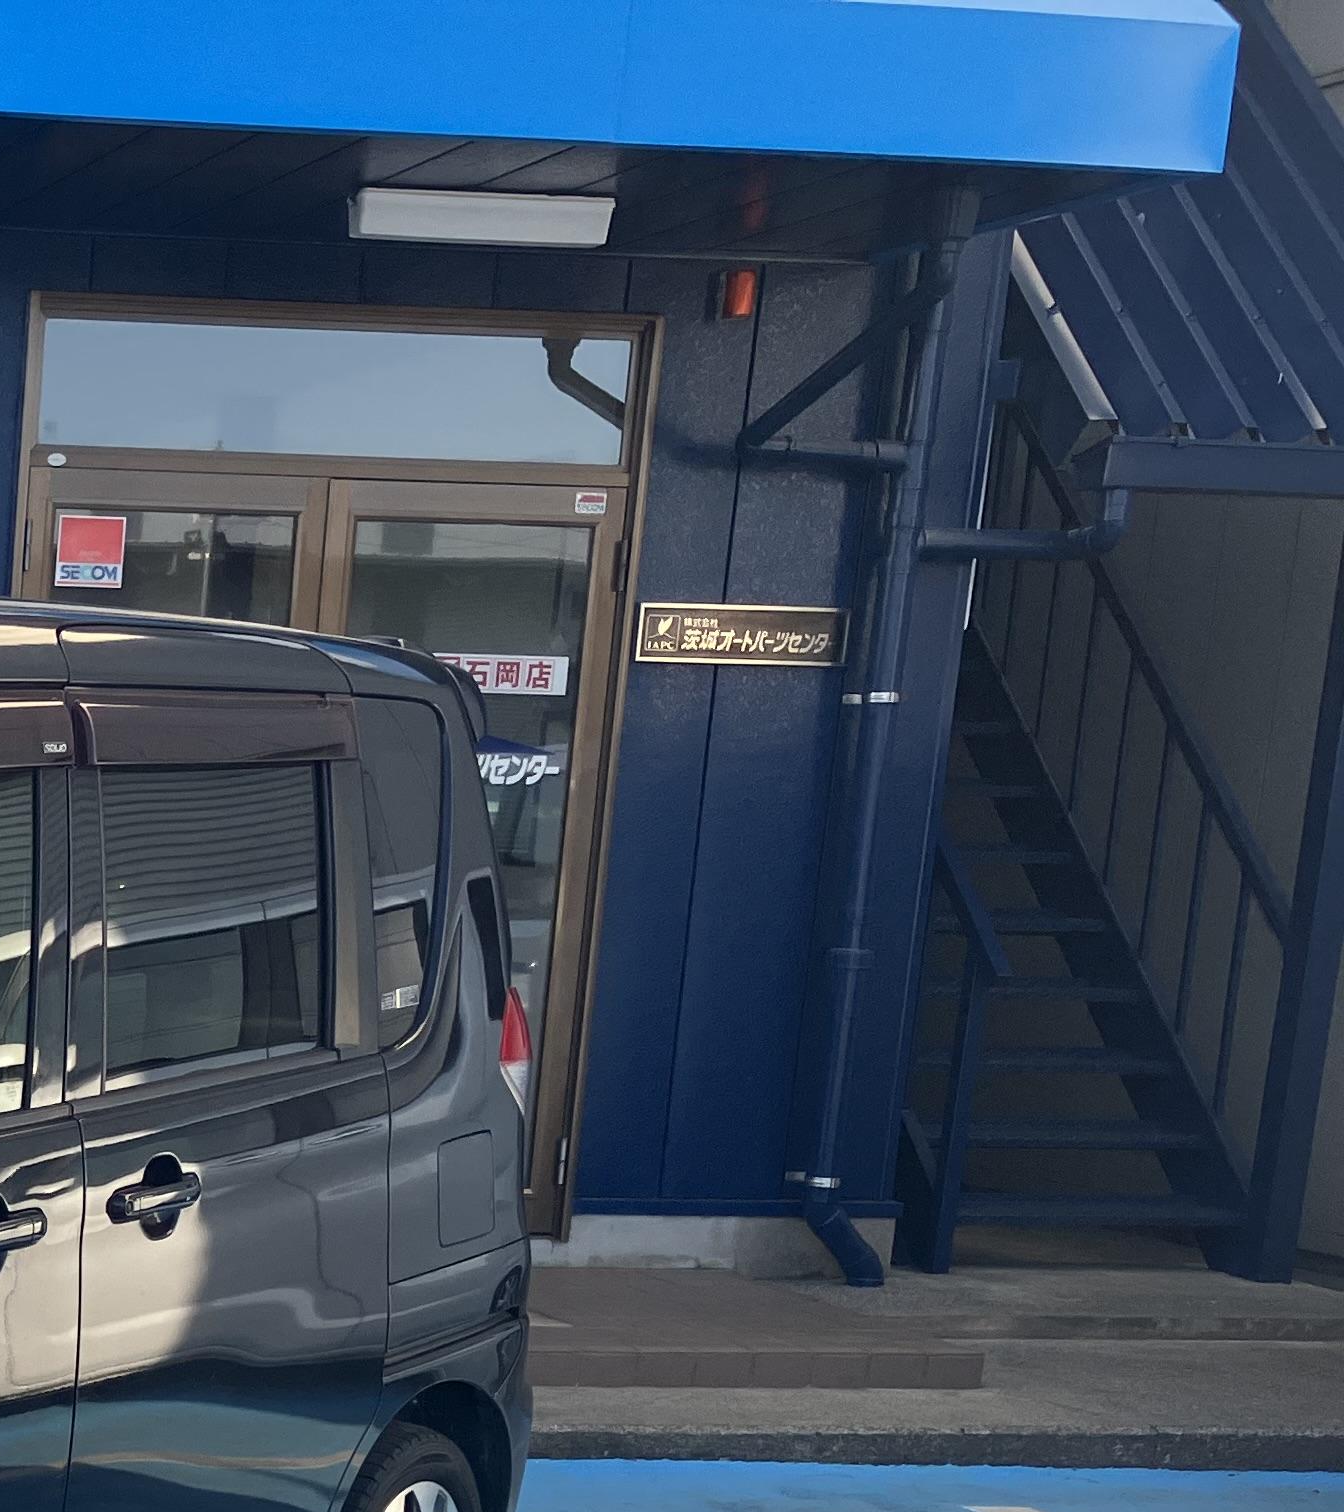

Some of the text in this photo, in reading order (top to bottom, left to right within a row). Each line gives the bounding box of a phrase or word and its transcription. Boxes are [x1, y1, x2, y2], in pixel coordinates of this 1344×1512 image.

[59, 564, 118, 581] SECOM
[435, 656, 552, 690] 石岡店
